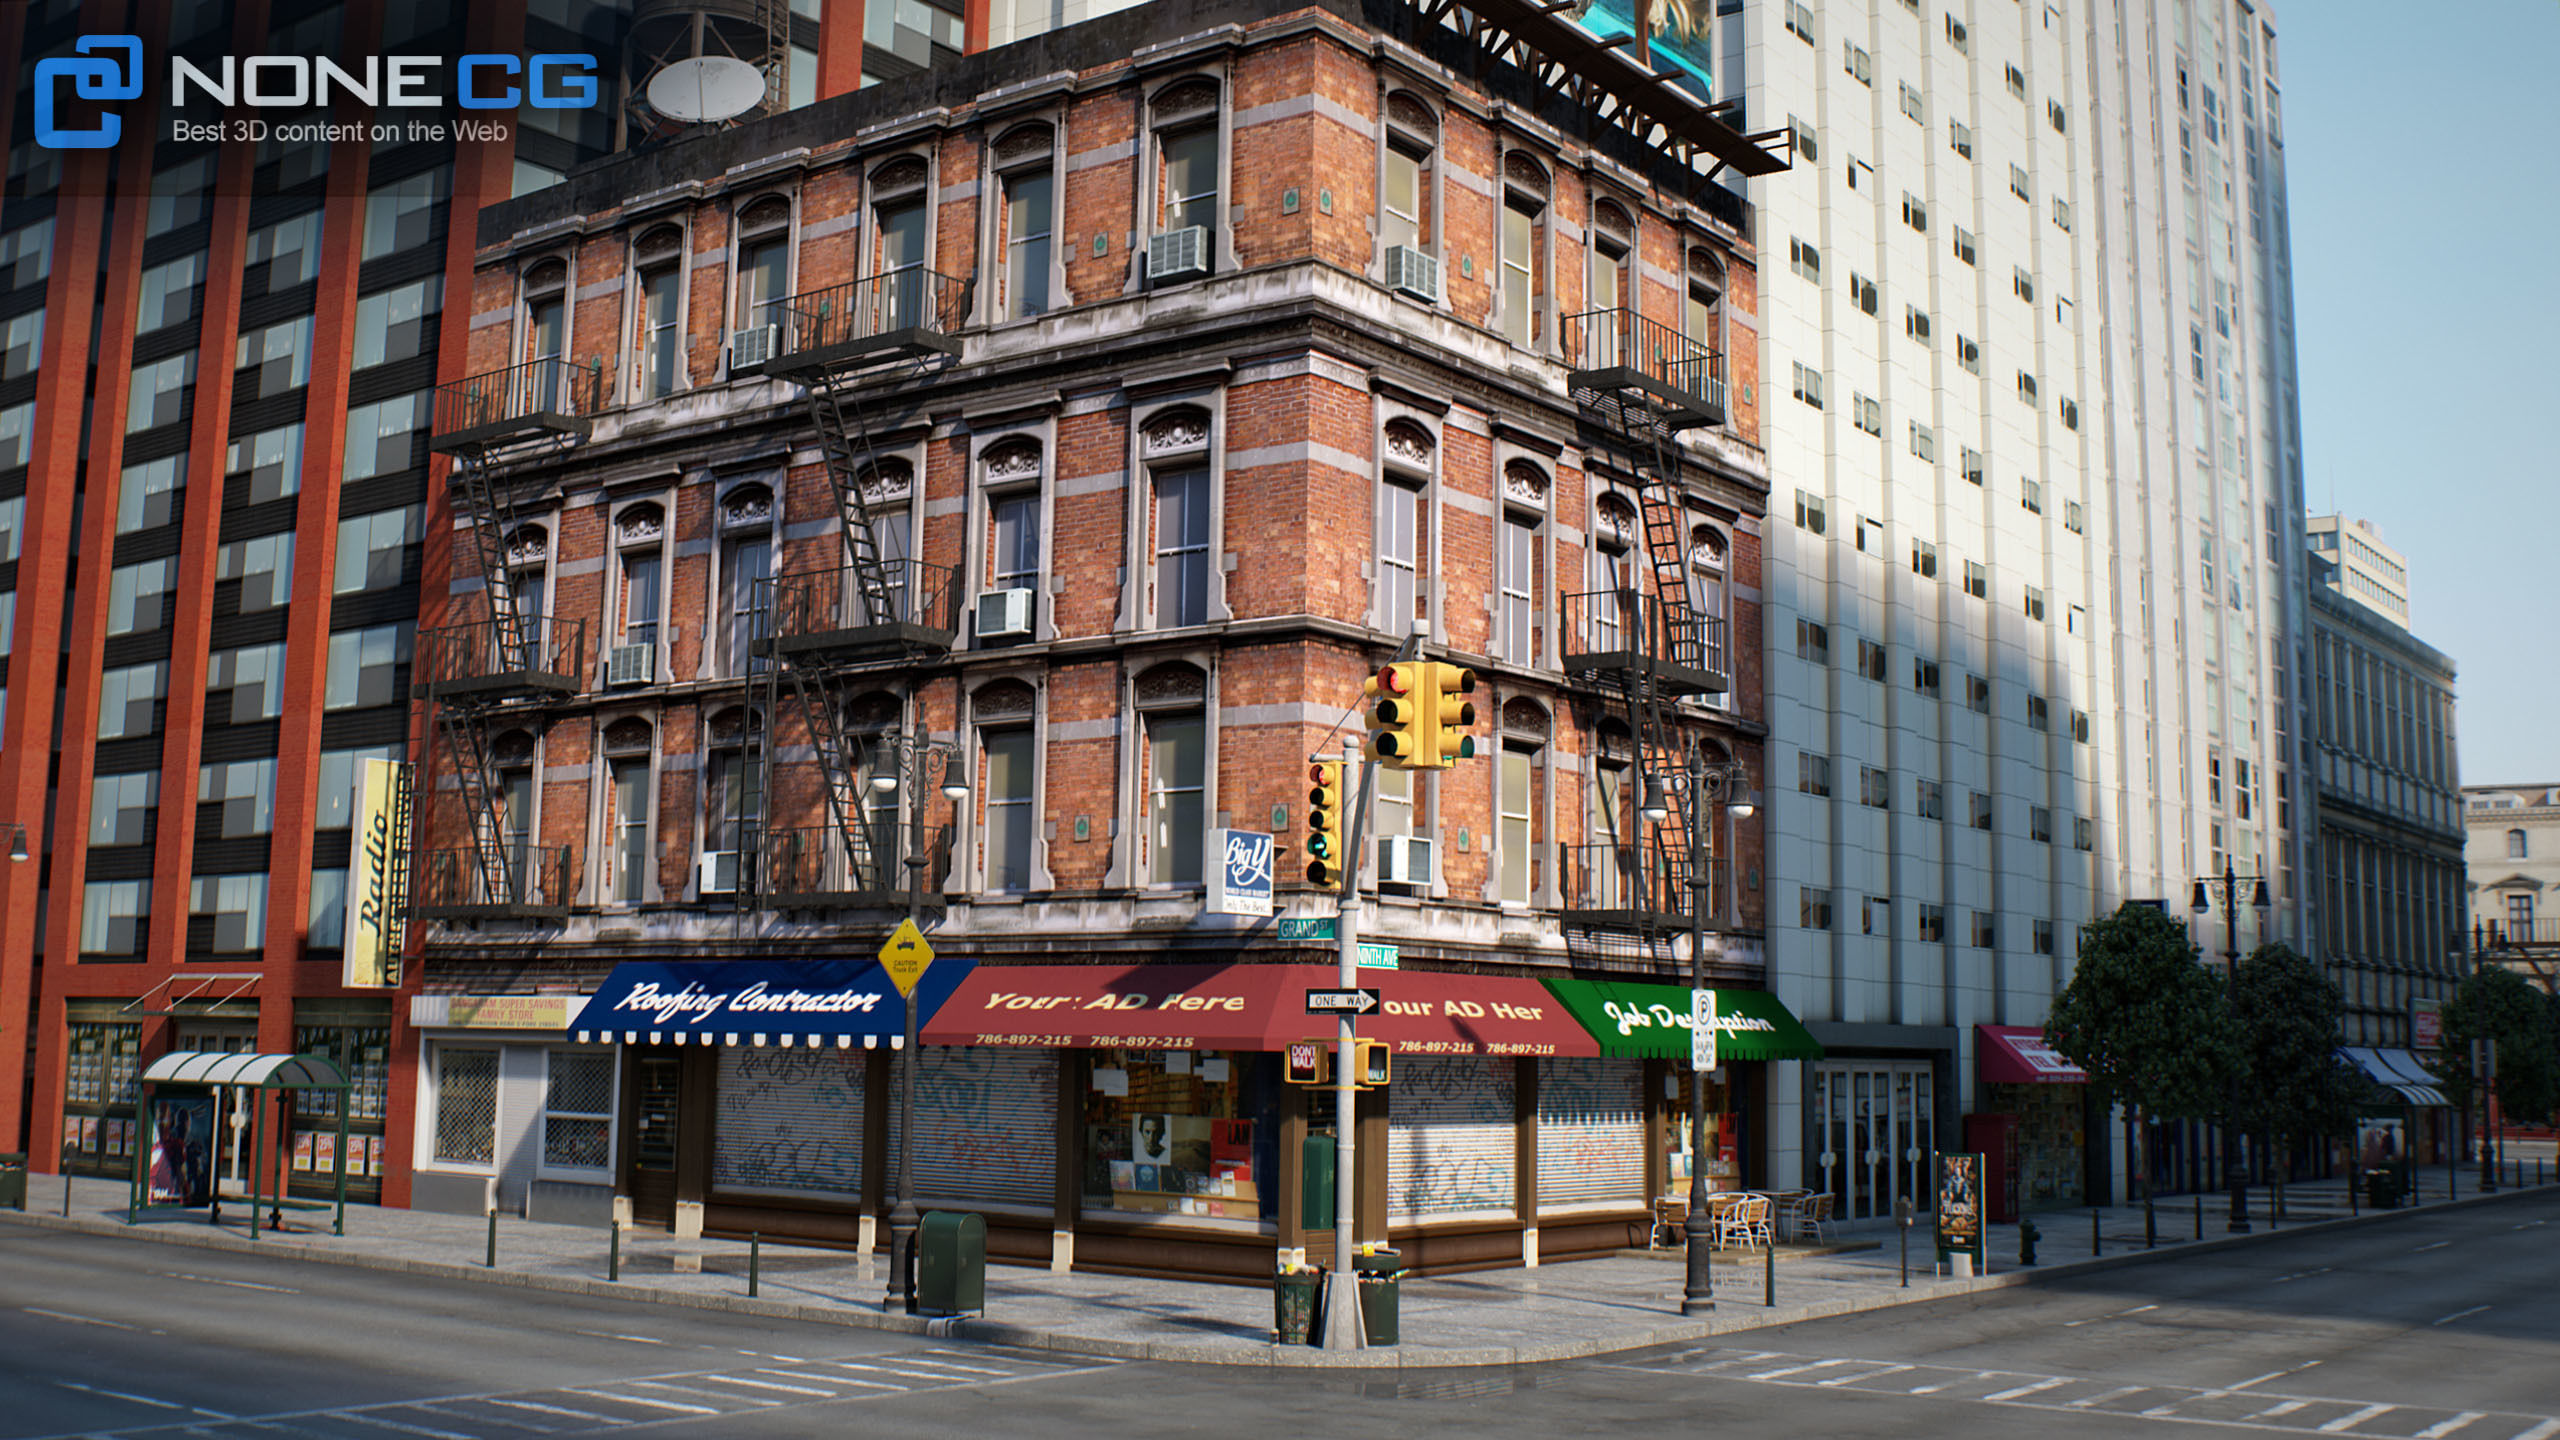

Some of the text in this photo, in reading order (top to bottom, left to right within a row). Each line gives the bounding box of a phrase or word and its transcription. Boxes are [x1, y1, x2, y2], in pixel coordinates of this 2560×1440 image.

[361, 809, 388, 938] Radio
[1281, 920, 1329, 938] GRAND ST
[1383, 949, 1399, 967] AVE
[498, 998, 526, 1009] SUPER
[528, 999, 565, 1010] SAVINGS
[613, 981, 882, 1025] Roofing Contractor
[1083, 993, 1149, 1011] AD
[1315, 995, 1369, 1007] ONE WAY
[1444, 1000, 1486, 1018] AD
[477, 1008, 535, 1020] FAMILY STORE
[1603, 1001, 1652, 1036] Job
[976, 1034, 1195, 1048] 786-897-215 786-897-215
[1399, 1041, 1556, 1055] 786-897-215 786-897-215
[1291, 1055, 1316, 1068] WALK
[1368, 1069, 1386, 1081] WALK
